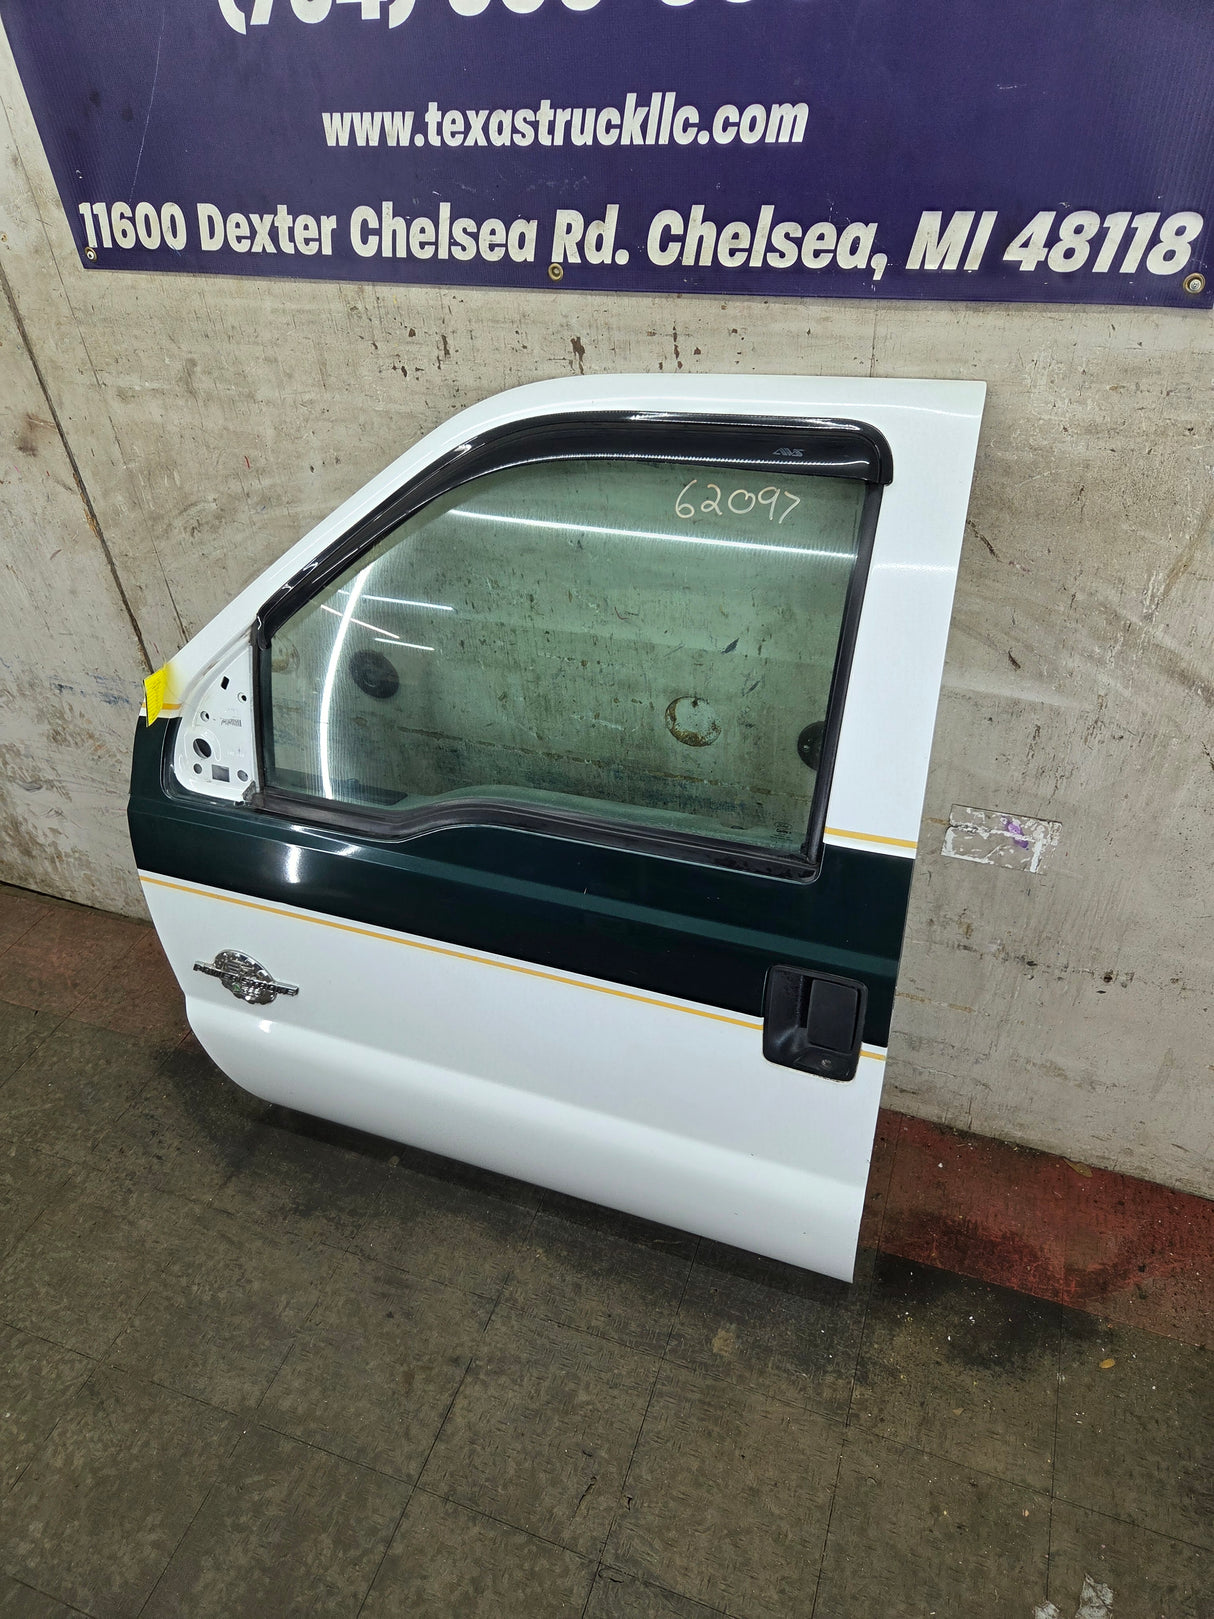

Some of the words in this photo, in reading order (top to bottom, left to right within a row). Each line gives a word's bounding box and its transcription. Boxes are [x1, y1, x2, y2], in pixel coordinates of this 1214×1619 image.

[321, 92, 809, 147] www.texastruckllc.com
[78, 201, 187, 251] 11600
[196, 202, 337, 256] Dexter
[349, 201, 538, 263] Chelsea
[551, 204, 630, 265] Rd.
[646, 204, 889, 281] Chelsea,
[904, 210, 998, 272] MI
[1002, 211, 1204, 276] 48118
[675, 479, 801, 524] 62097
